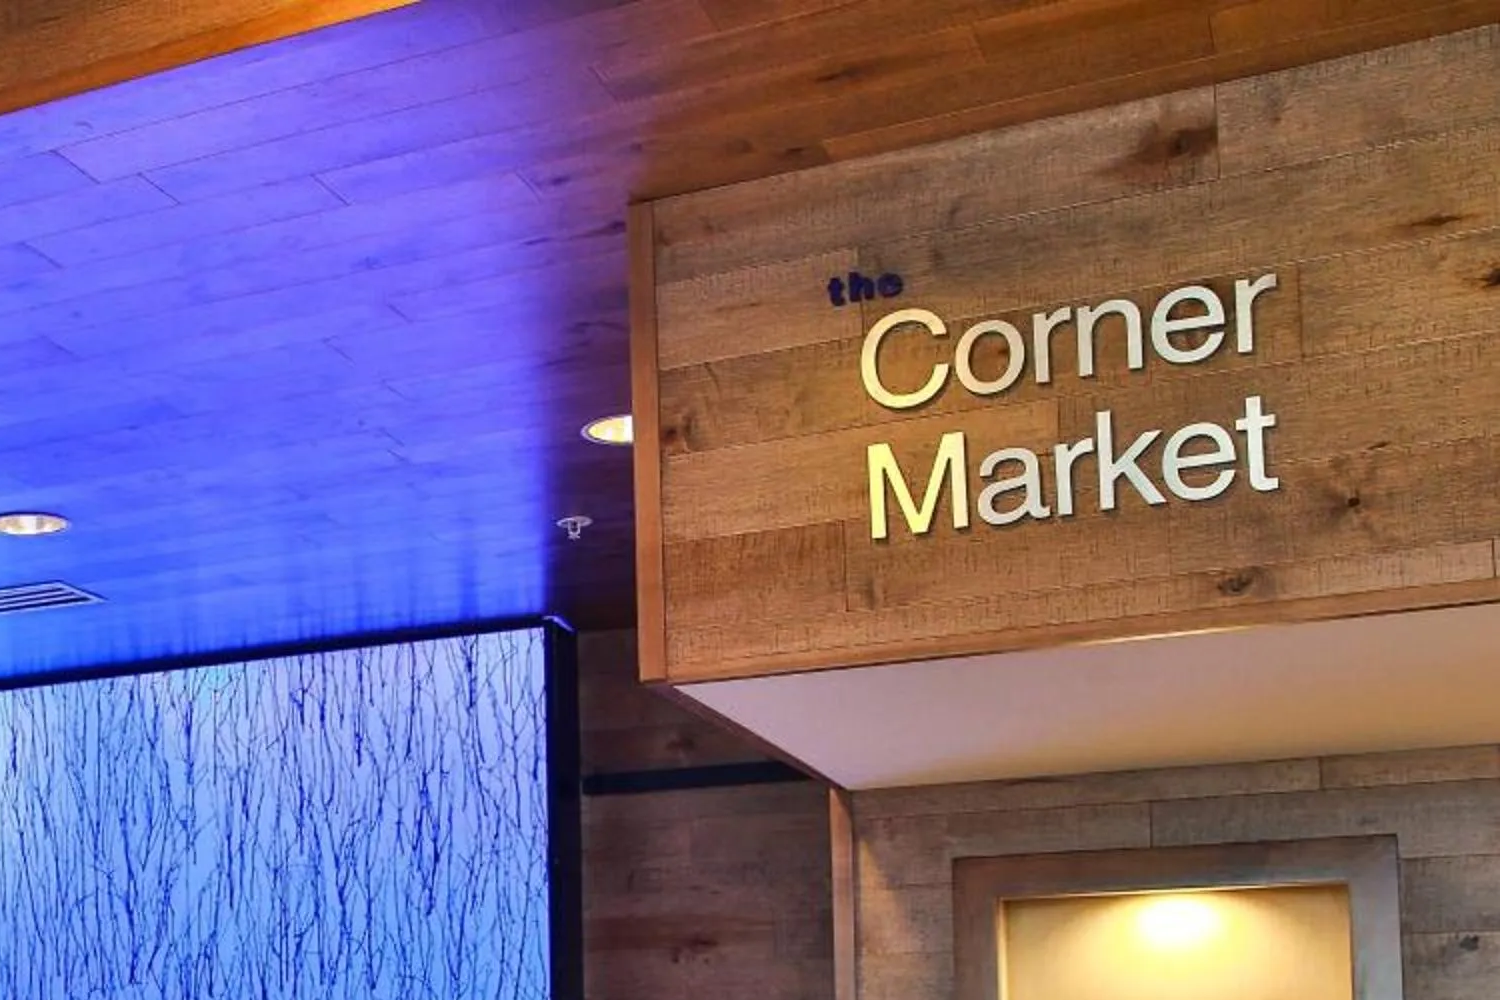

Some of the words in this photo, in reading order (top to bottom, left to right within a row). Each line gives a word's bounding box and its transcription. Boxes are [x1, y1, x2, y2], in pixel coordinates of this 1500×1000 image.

[828, 272, 903, 306] the
[860, 274, 1277, 409] Corner
[867, 396, 1279, 540] Market
